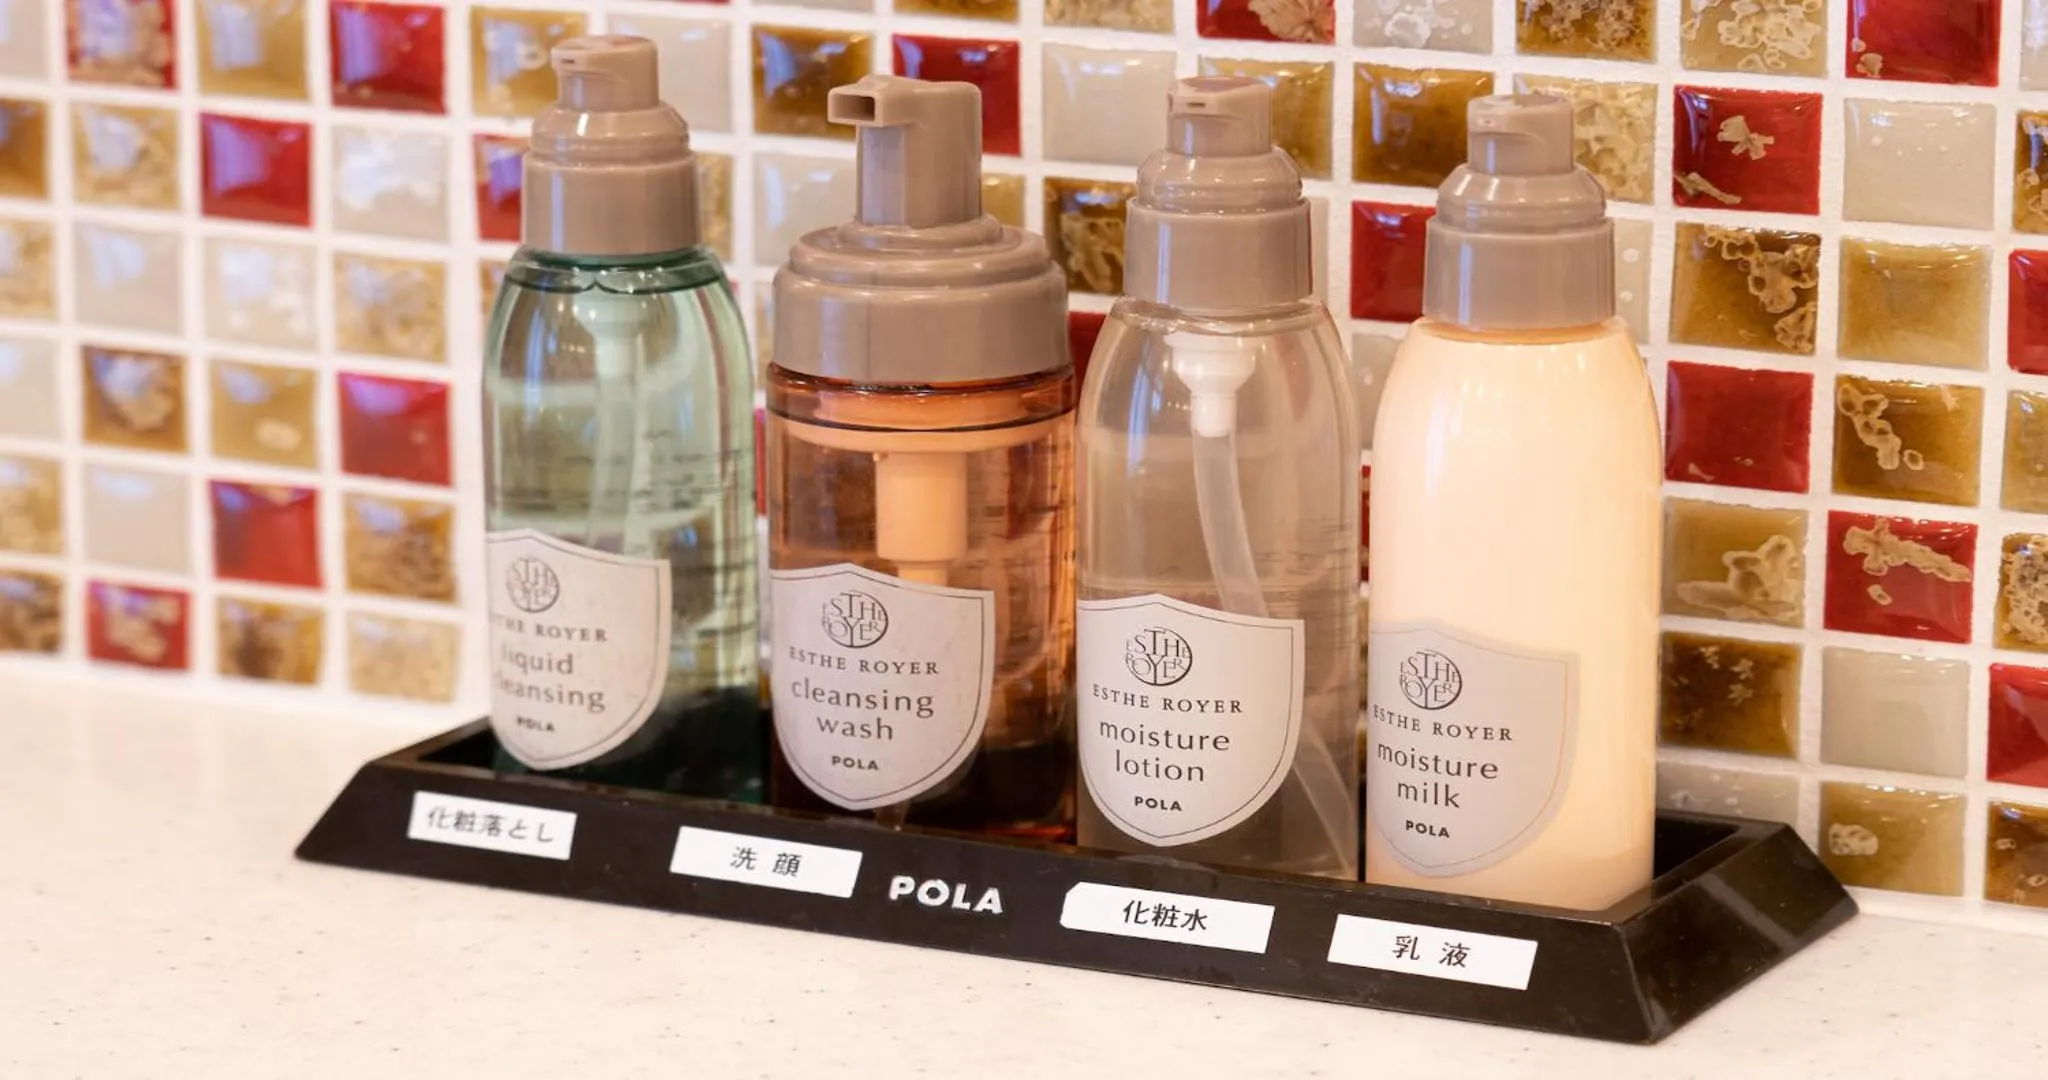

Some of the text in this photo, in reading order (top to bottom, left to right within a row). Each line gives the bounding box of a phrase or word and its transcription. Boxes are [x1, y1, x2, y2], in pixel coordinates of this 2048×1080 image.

[535, 623, 607, 642] ROYER
[1126, 629, 1191, 658] ESTHE
[502, 641, 573, 675] liquid
[789, 646, 939, 675] ESTHE ROYER
[1126, 653, 1187, 684] ROYER
[791, 678, 934, 719] cleansing
[1093, 684, 1243, 713] ESTHE ROYER
[516, 716, 555, 732] POLA
[817, 717, 893, 740] wash
[1099, 721, 1230, 751] moisture
[1373, 704, 1513, 741] ESTHE ROYER
[831, 756, 880, 771] POLA
[1115, 749, 1204, 782] lotion
[1378, 743, 1499, 779] moisture
[1134, 796, 1182, 811] POLA
[1398, 781, 1460, 808] milk
[428, 806, 554, 842] 化粧落とし
[1405, 820, 1450, 838] POLA
[889, 875, 1003, 914] POLA
[1123, 900, 1207, 931] 化粧水
